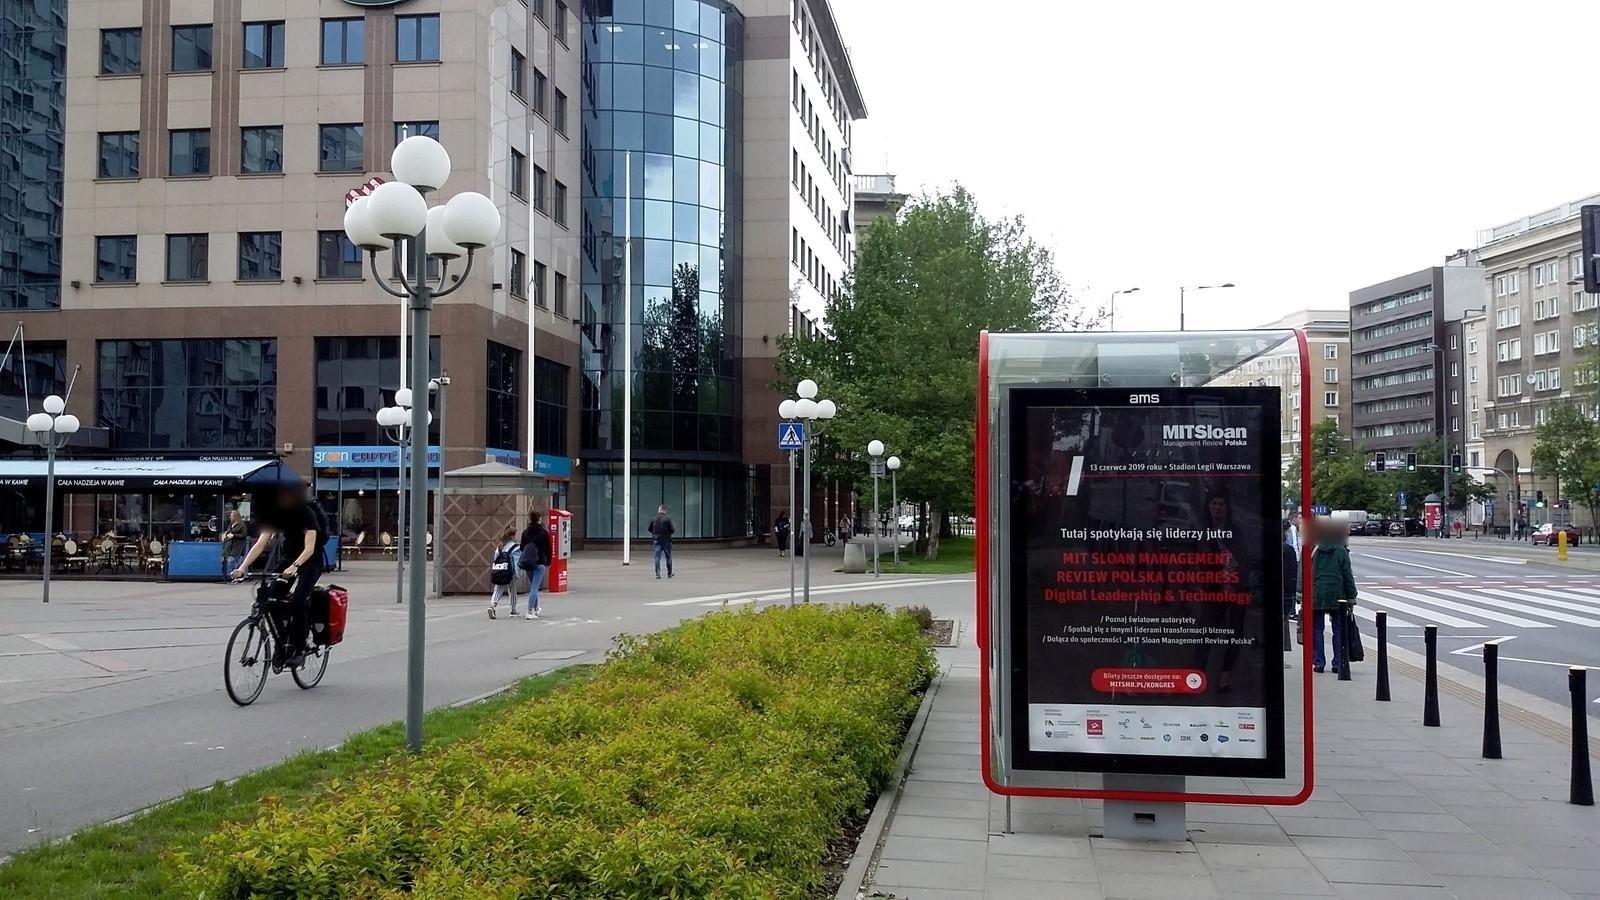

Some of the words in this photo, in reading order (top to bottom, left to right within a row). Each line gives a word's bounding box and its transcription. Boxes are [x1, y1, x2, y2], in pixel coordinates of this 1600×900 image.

[1129, 393, 1160, 404] ams
[1162, 424, 1247, 439] MITSloan
[1197, 463, 1214, 472] Legii
[1060, 528, 1087, 540] Tutaj
[1090, 528, 1143, 541] spotykają
[1146, 528, 1163, 541] się
[1165, 528, 1203, 540] liderzy
[1206, 528, 1233, 540] jutra
[1063, 552, 1088, 564] MIT
[1091, 552, 1135, 564] SLOAN
[1138, 552, 1233, 565] MANAGEMENT
[1056, 572, 1108, 582] REVIEW
[1112, 572, 1164, 583] POLSKA
[1168, 572, 1240, 584] CONGRESS
[1044, 589, 1088, 603] Digital
[1090, 590, 1161, 603] Leadership
[1164, 590, 1175, 602] &
[1179, 590, 1252, 605] Technology
[1105, 616, 1127, 624] Poznaj
[1128, 616, 1160, 624] światowe
[1160, 616, 1196, 624] autorytety
[1068, 626, 1093, 634] Spotkaj
[1094, 626, 1104, 634] się
[1110, 626, 1132, 634] innymi
[1134, 626, 1162, 634] liderami
[1162, 626, 1208, 635] transformacji
[1046, 636, 1069, 644] Dołącz
[1080, 636, 1122, 645] społeczności
[1162, 637, 1203, 646] Management
[1103, 672, 1120, 680] Bilety
[1120, 672, 1143, 681] jeszcze
[1144, 672, 1171, 682] dostępne
